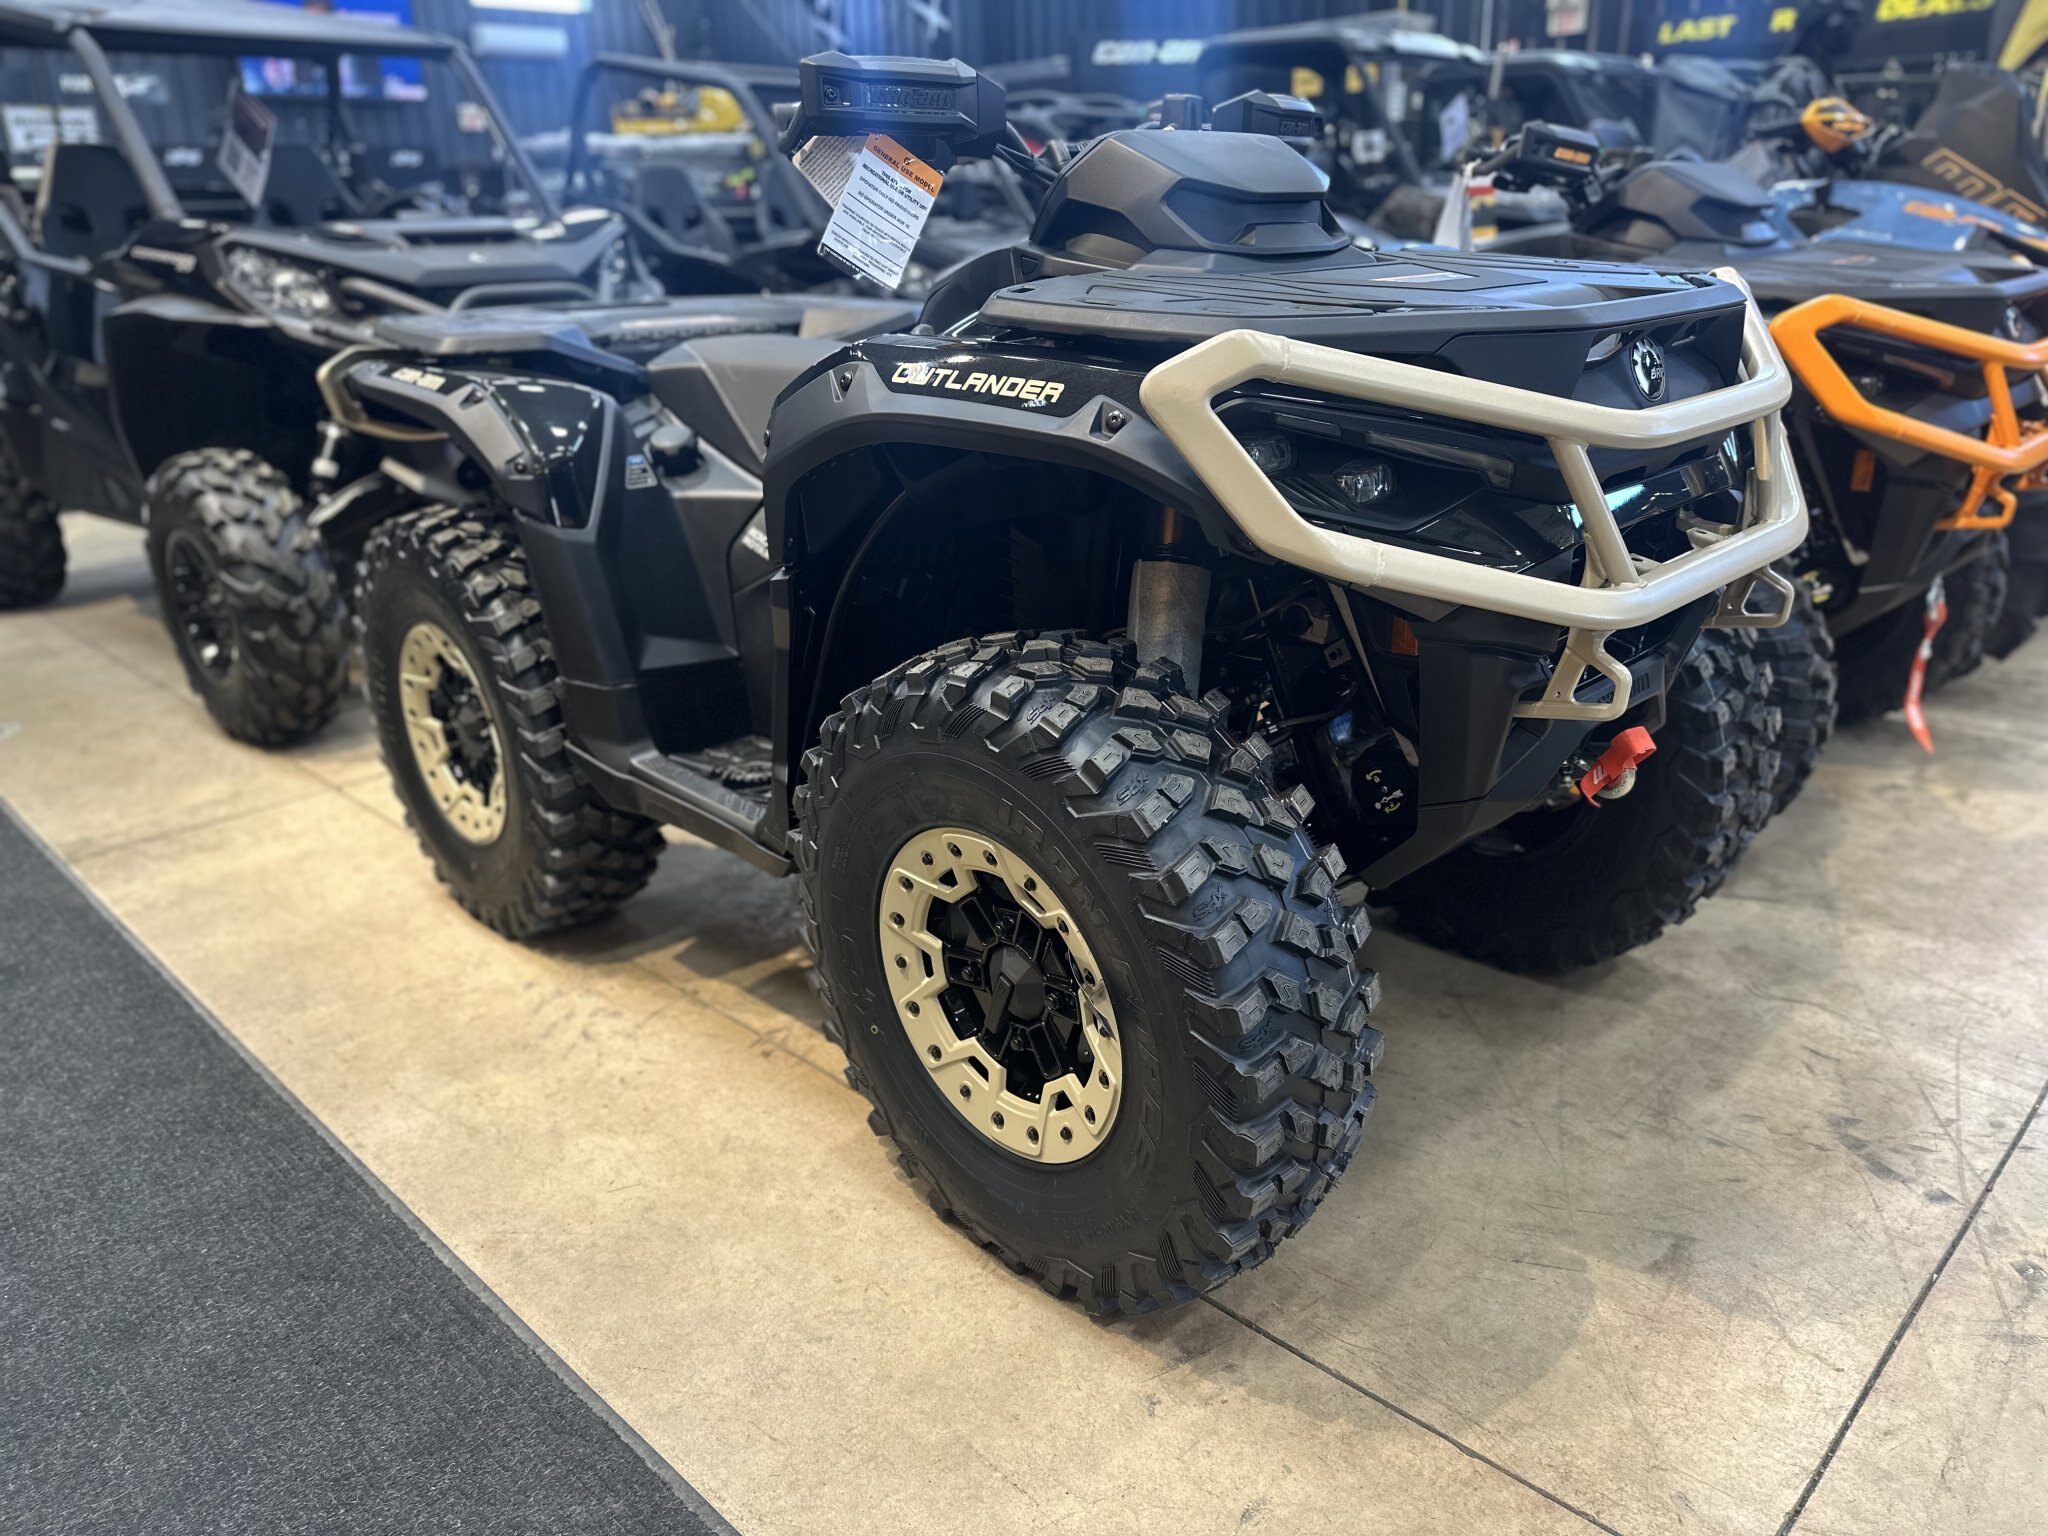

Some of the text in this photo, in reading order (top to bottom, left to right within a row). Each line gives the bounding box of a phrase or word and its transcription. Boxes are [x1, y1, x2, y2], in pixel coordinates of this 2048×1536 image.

[1657, 14, 1737, 45] LAST
[872, 144, 935, 193] GENERAL USE MODEL
[891, 362, 1065, 403] OUTLANDER
